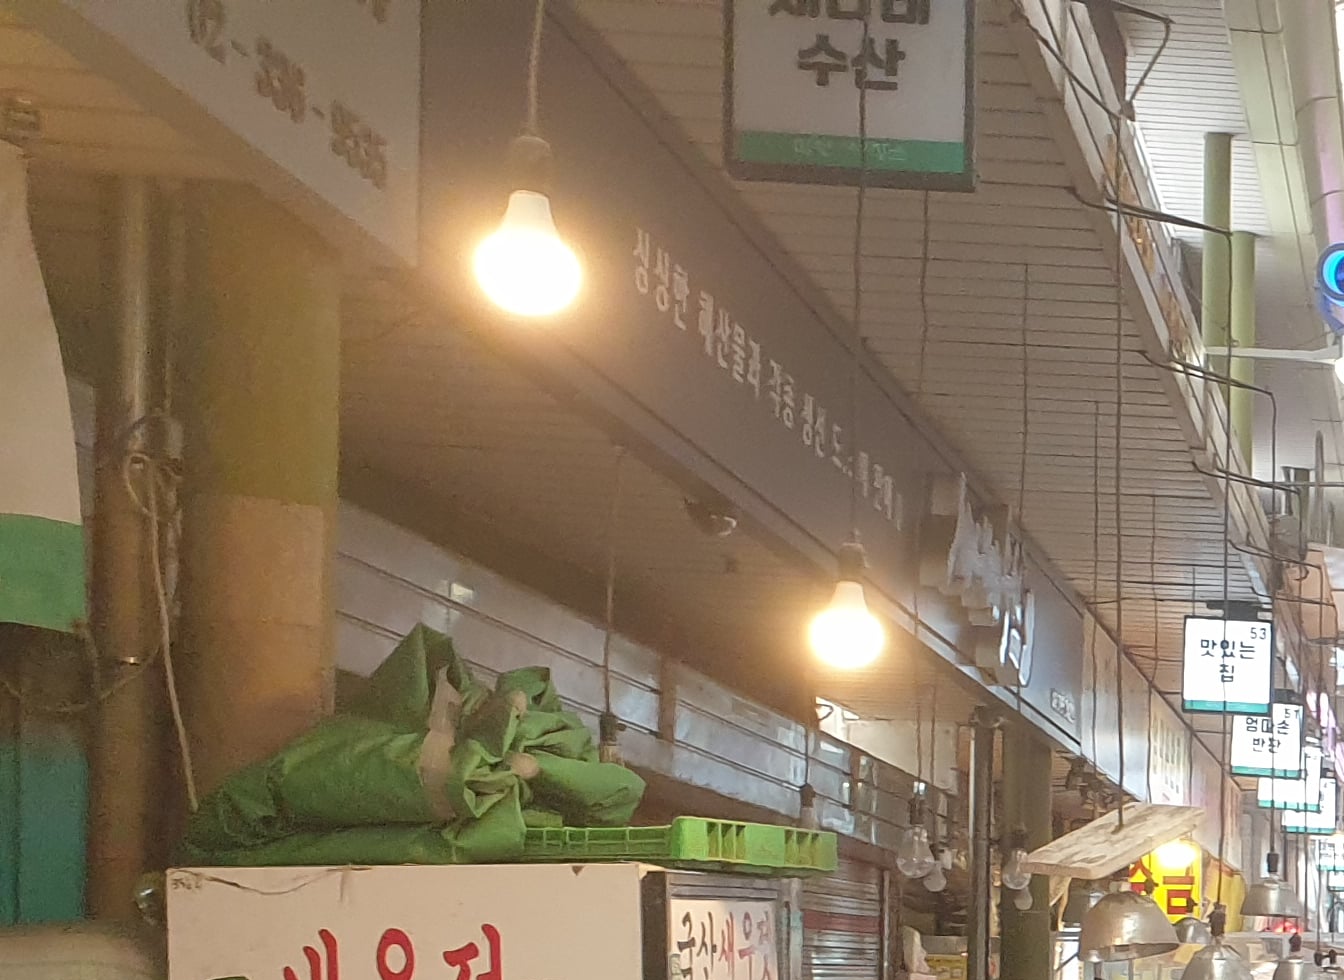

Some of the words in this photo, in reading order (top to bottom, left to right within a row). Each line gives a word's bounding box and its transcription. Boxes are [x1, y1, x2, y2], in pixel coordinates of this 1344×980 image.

[797, 34, 906, 90] 수산
[634, 228, 690, 331] 싱싱한
[699, 290, 761, 398] 해산물과
[1200, 639, 1256, 660] 맛있는
[1250, 627, 1268, 640] 53
